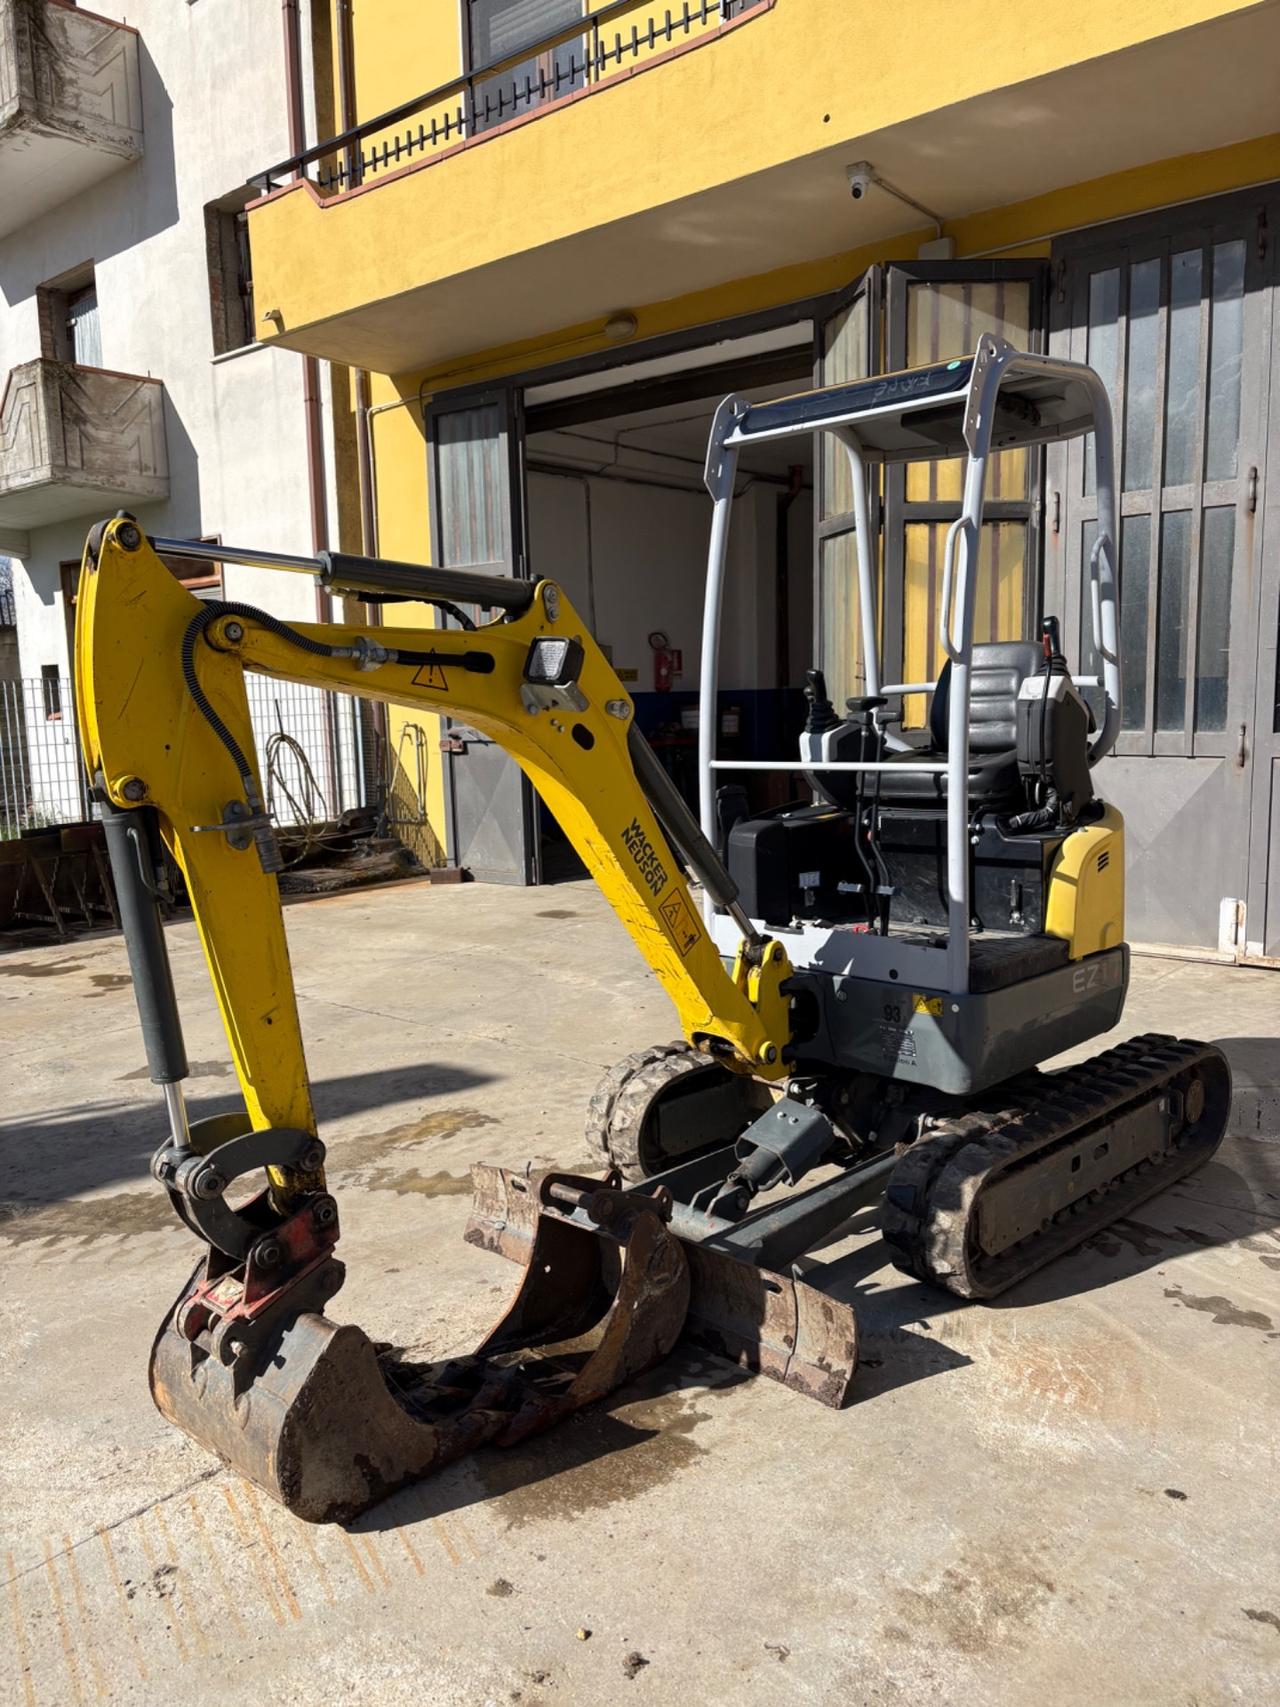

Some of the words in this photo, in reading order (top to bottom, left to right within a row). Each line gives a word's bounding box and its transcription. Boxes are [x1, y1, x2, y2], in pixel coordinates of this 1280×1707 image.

[621, 827, 662, 897] NEUSON
[630, 817, 668, 888] WACKER
[884, 1004, 900, 1023] 93
